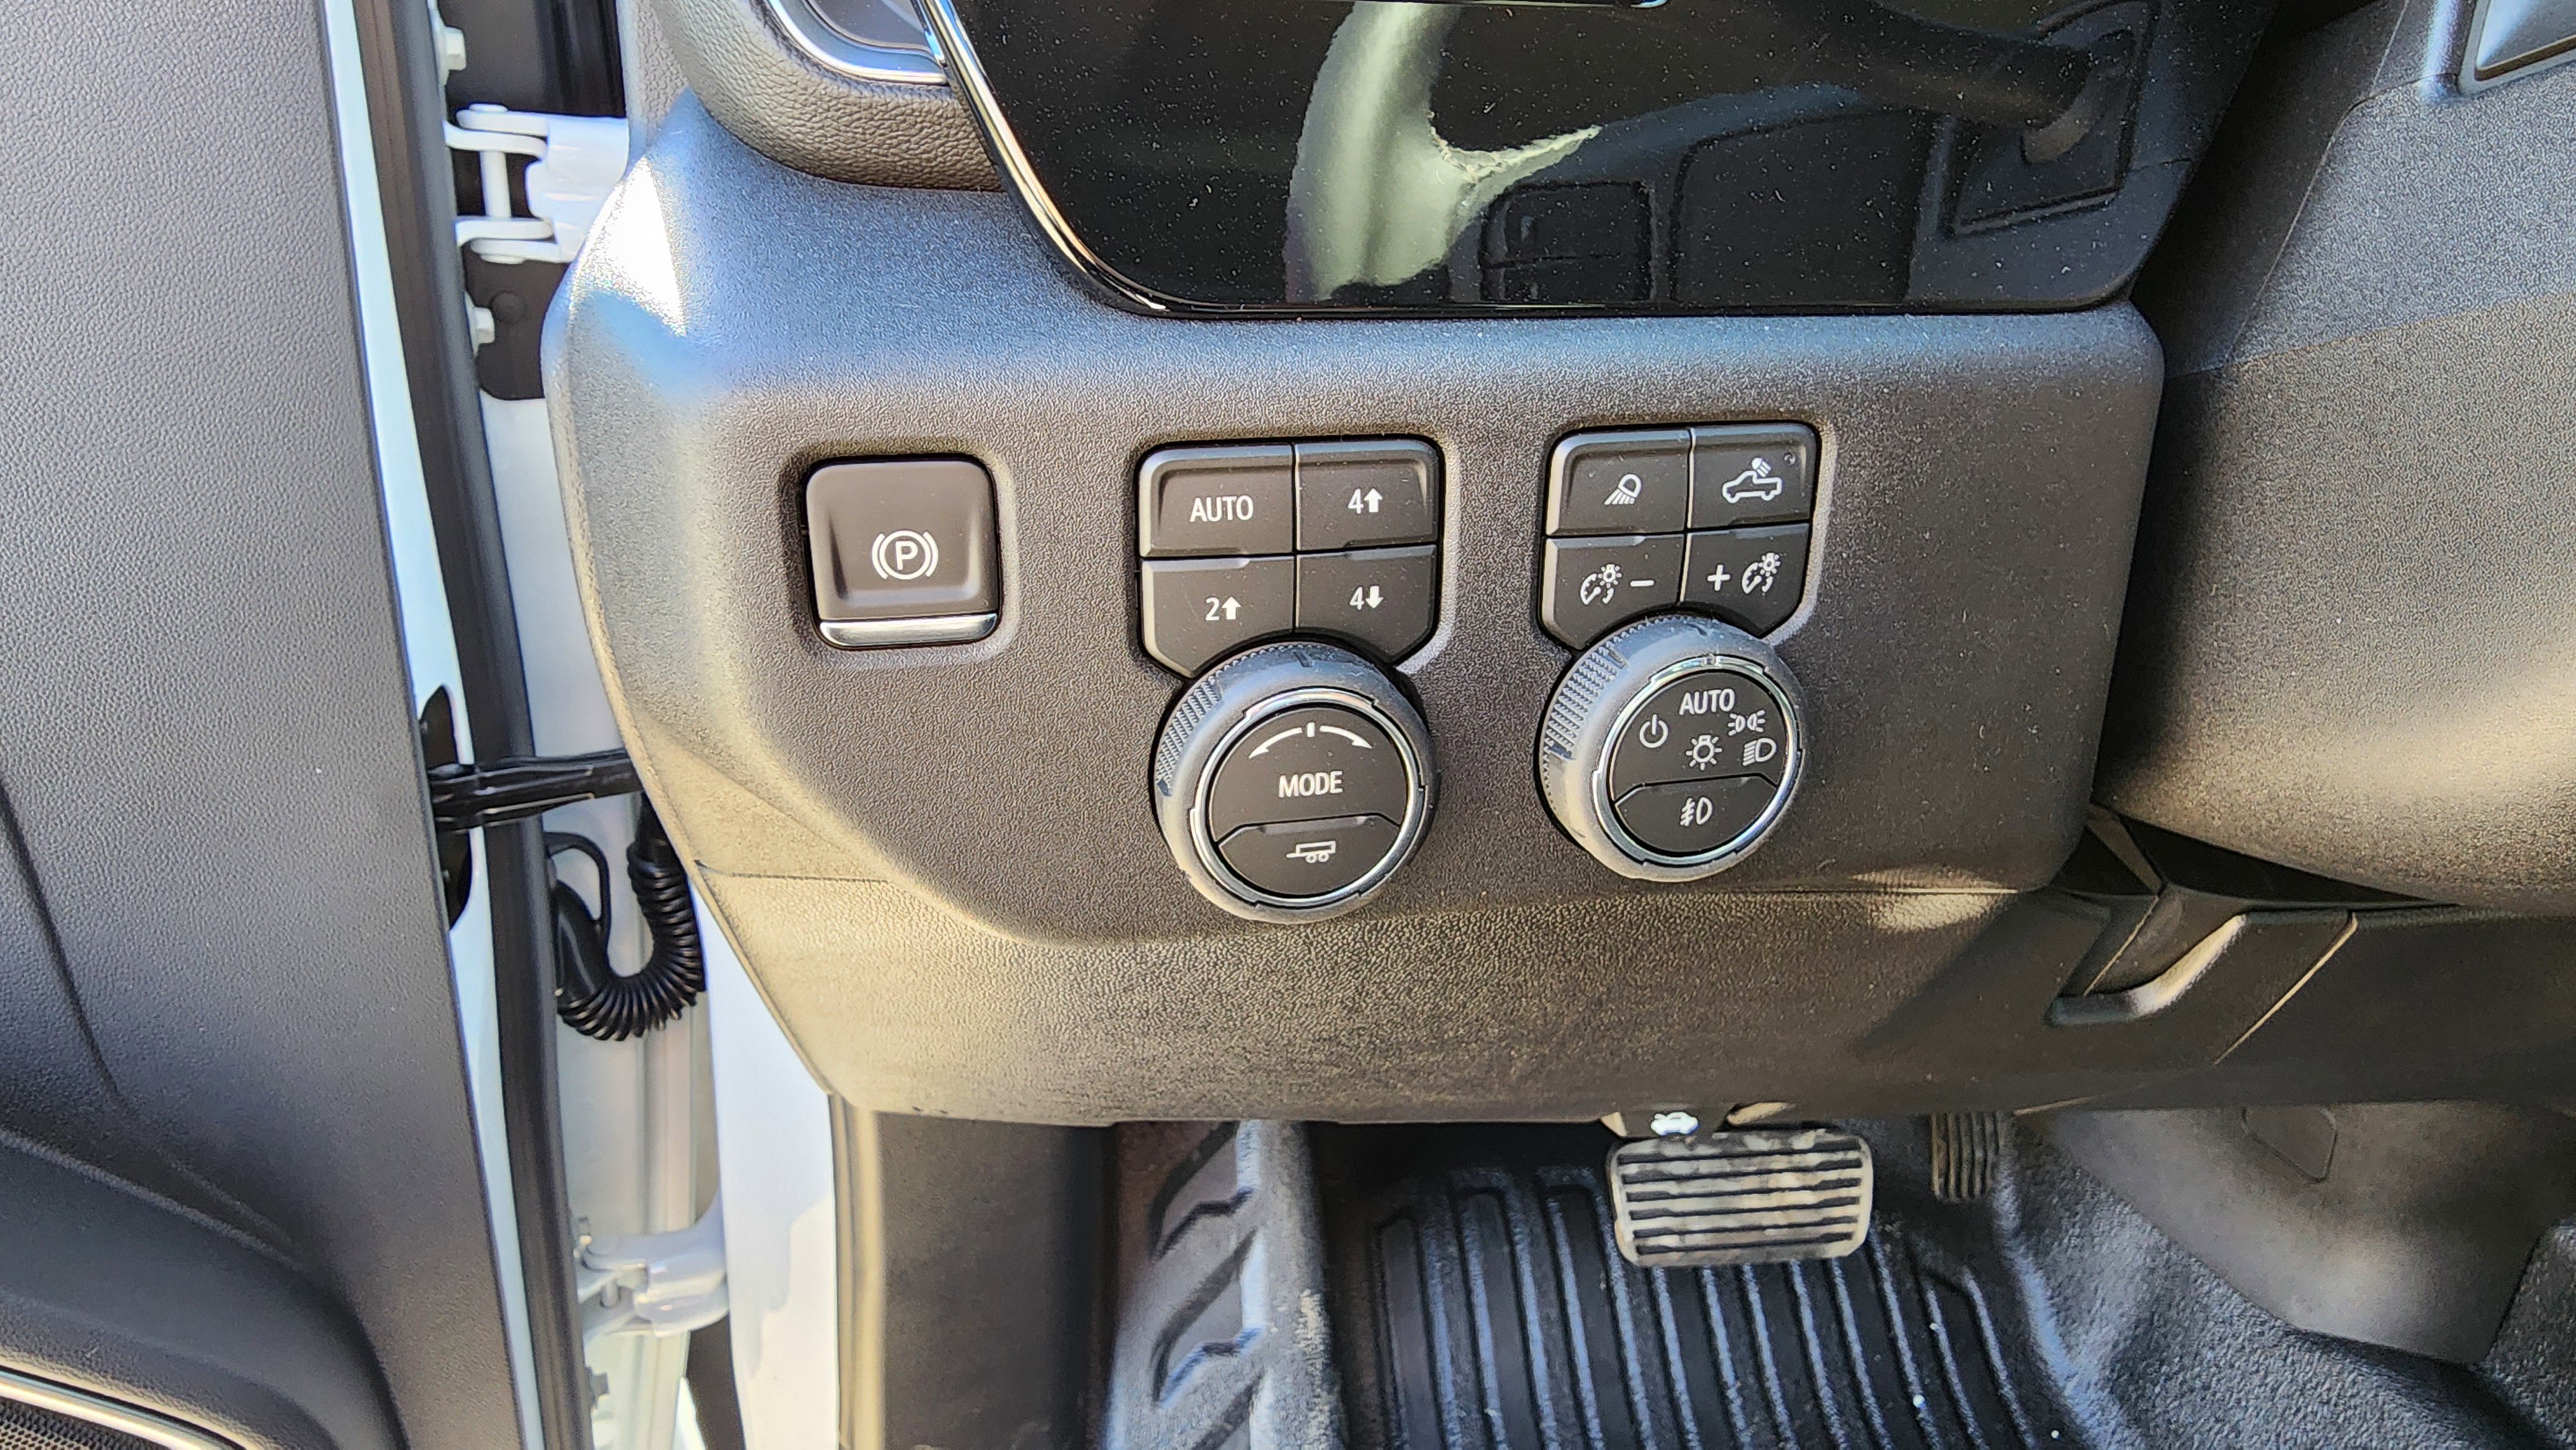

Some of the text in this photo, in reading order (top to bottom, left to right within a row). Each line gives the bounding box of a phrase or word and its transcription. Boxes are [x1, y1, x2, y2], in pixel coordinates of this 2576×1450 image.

[1189, 494, 1254, 523] AUTO
[895, 540, 918, 570] P
[1678, 688, 1736, 715] AUTO
[1278, 771, 1343, 798] MODE
